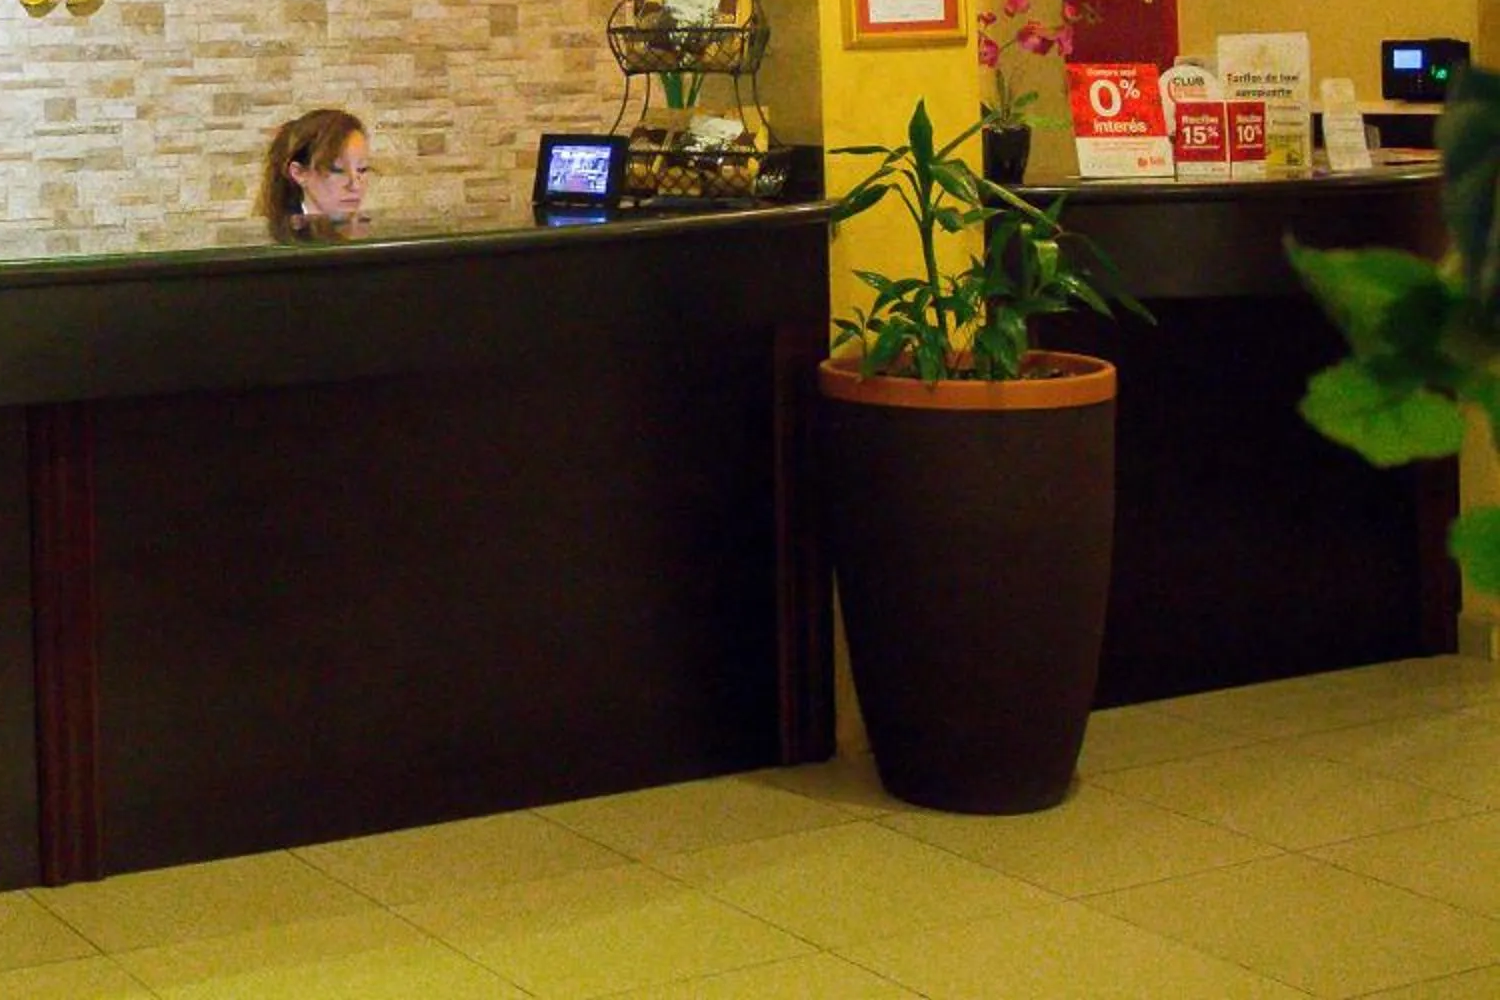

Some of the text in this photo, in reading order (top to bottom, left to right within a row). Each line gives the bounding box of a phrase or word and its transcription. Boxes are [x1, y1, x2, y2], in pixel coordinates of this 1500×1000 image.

[1173, 76, 1205, 87] CLUB
[1089, 79, 1141, 117] 0%
[1182, 124, 1219, 145] 15%
[1236, 124, 1262, 143] 10%
